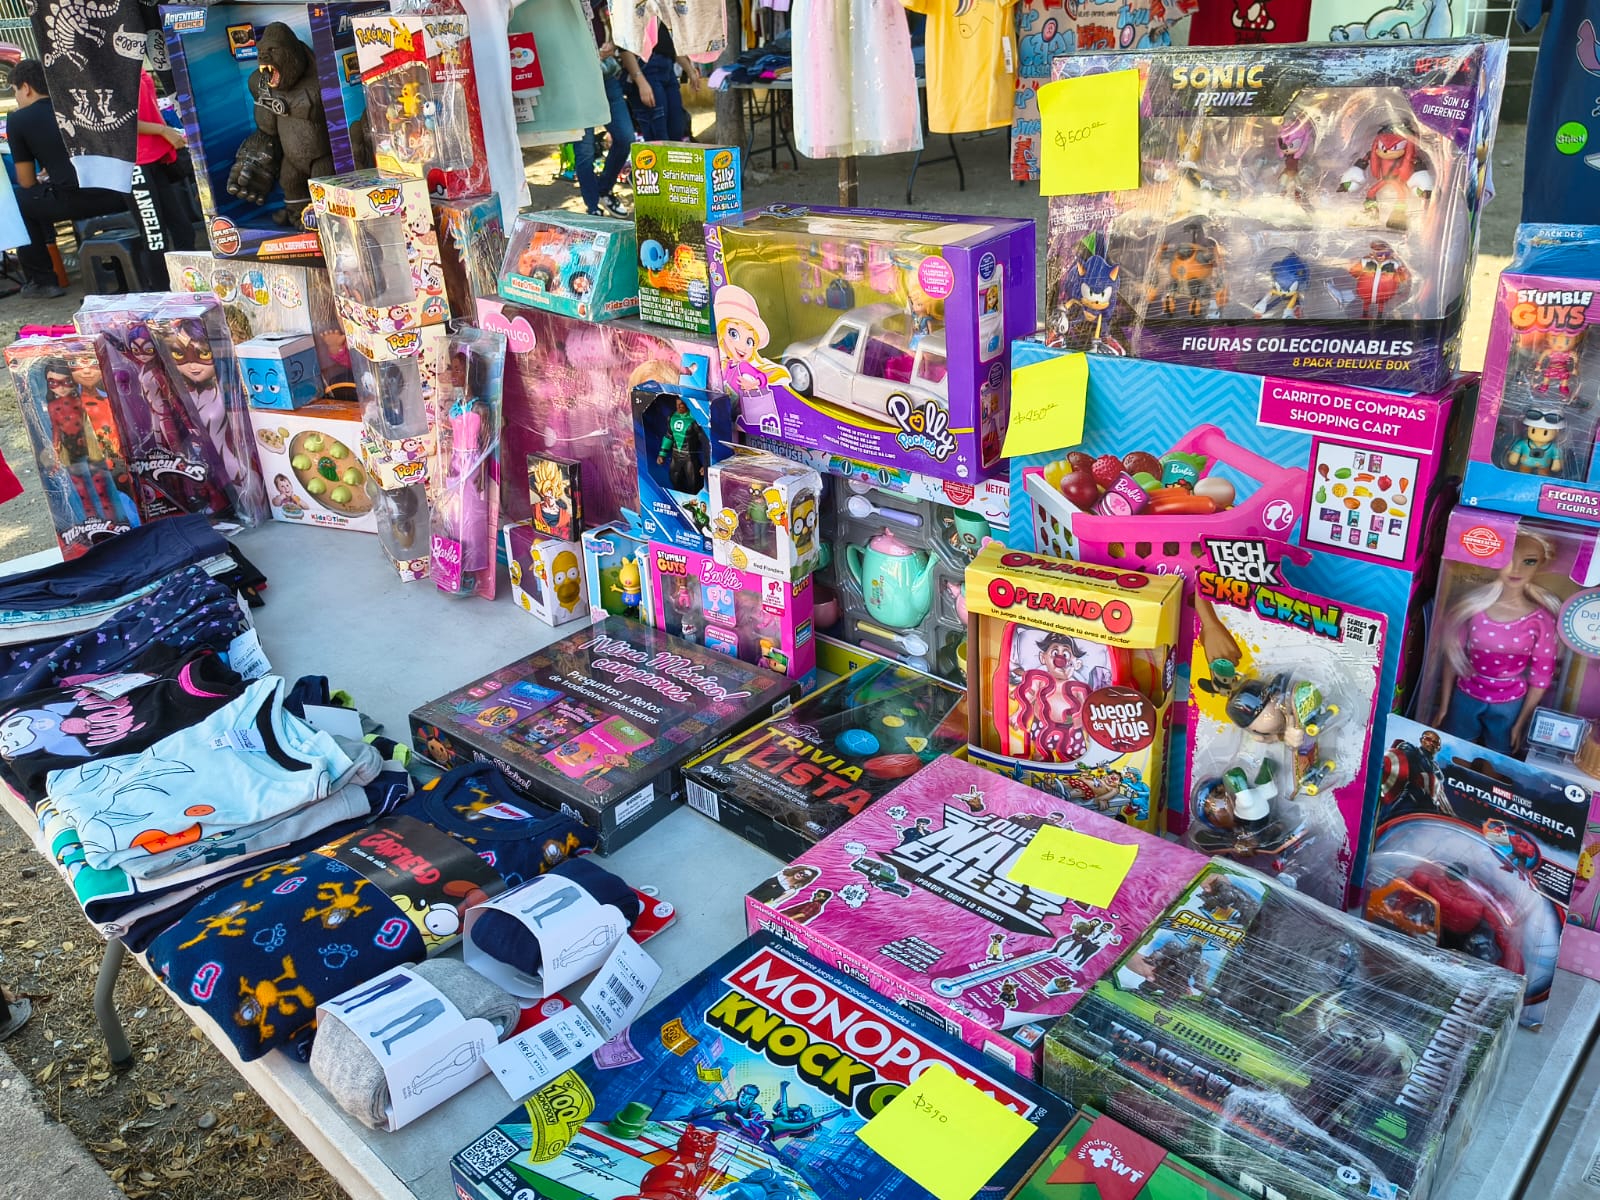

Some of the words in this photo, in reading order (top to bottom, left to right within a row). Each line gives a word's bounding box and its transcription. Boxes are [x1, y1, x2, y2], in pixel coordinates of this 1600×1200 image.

[164, 10, 205, 26] ADVENTURE
[176, 20, 202, 29] FORCE
[1172, 66, 1264, 90] SONIC
[1194, 91, 1258, 107] PRIME
[1442, 96, 1458, 107] SON
[1459, 98, 1469, 108] 16
[1422, 104, 1466, 120] DIFERENTES
[694, 153, 703, 163] 3+
[635, 169, 659, 185] Silly
[662, 170, 680, 180] Safari
[680, 171, 704, 183] Animals
[712, 168, 734, 184] Silly
[637, 185, 660, 194] scents
[669, 183, 698, 195] Animales
[713, 181, 735, 192] scents
[367, 187, 400, 207] POP!
[669, 193, 679, 203] del
[680, 195, 699, 205] safari
[713, 193, 736, 203] DOUGH
[328, 202, 356, 218] LABUBU
[711, 201, 739, 212] MASILLA
[133, 189, 164, 251] ANGELES
[1540, 230, 1563, 238] PACK
[1517, 289, 1593, 306] STUMBLE
[1511, 303, 1585, 328] GUYS
[386, 333, 417, 351] POP!
[1182, 337, 1252, 351] FIGURAS
[1257, 338, 1414, 356] COLECCIONABLES
[1292, 358, 1299, 367] 8
[1303, 358, 1333, 368] PACK
[1336, 359, 1383, 370] DELUXE
[1386, 360, 1411, 371] BOX
[1272, 387, 1331, 407] CARRITO
[1333, 395, 1351, 409] DE
[1354, 400, 1426, 421] COMPRAS
[888, 396, 956, 459] Polly
[1289, 408, 1360, 431] SHOPPING
[1362, 419, 1402, 436] CART
[898, 433, 936, 455] Pocket
[957, 454, 967, 463] 4+
[393, 460, 423, 478] POP!
[1171, 464, 1196, 477] Barbie
[985, 482, 1010, 497] NETFLI
[1115, 478, 1143, 503] Barbie
[1548, 490, 1598, 505] FIGURAS
[653, 501, 671, 510] GREEN
[653, 507, 678, 517] LANTERN
[1556, 502, 1599, 515] FIGURAS
[644, 520, 656, 532] DC
[432, 537, 460, 564] Barbie
[657, 550, 687, 564] STUMBLE
[1206, 540, 1266, 564] TECH
[657, 559, 687, 575] GUYS
[700, 559, 743, 589] Barbie
[763, 564, 785, 575] Flanders
[1001, 552, 1149, 589] OPERANDO
[1218, 560, 1281, 585] DECK
[793, 579, 809, 597] GUYS
[987, 577, 1133, 634] OPERANDO
[1199, 571, 1251, 608] SK8
[1254, 585, 1342, 640] CREW
[991, 607, 1000, 615] Un
[1000, 610, 1017, 619] juego
[1027, 616, 1054, 628] habilidad
[1055, 623, 1075, 633] donde
[1107, 635, 1131, 645] doctor
[1346, 625, 1364, 635] SERIE
[1347, 617, 1367, 629] SERIES
[1346, 632, 1364, 642] SERIE
[1366, 624, 1378, 645] 1
[645, 651, 751, 702] México!
[549, 674, 559, 683] de
[560, 677, 609, 705] tradiciones
[608, 700, 660, 725] mexicanas
[567, 671, 620, 698] Preguntas
[620, 692, 630, 703] y
[629, 694, 664, 714] Retos
[1090, 700, 1143, 722] Juegos
[1093, 720, 1104, 731] de
[738, 727, 863, 783] TRIVIA
[747, 746, 872, 816] LISTA
[1493, 786, 1512, 800] MARVEL
[1512, 794, 1532, 808] STUDIOS
[1569, 789, 1583, 799] 4+
[1447, 777, 1507, 809] CAPTAIN
[1508, 803, 1576, 838] AMERICA
[359, 833, 441, 885] GARFIELD
[893, 840, 1064, 921] ERES?
[944, 890, 967, 905] TODOS
[967, 901, 976, 910] LO
[975, 904, 1004, 923] SOMOS!
[1176, 911, 1243, 945] SMASH
[837, 959, 850, 974] 10
[850, 968, 870, 983] años
[781, 948, 816, 971] emocionante
[815, 967, 833, 981] juego
[833, 977, 843, 985] de
[841, 984, 870, 1001] negociar
[868, 999, 910, 1026] propiedades
[709, 993, 870, 1096] KNOCK
[1172, 1021, 1242, 1062] RHINOX
[537, 1092, 558, 1125] MONOPOLY
[543, 1085, 580, 1119] 100
[495, 1170, 503, 1179] DE
[501, 1174, 517, 1191] MESA
[500, 1167, 518, 1182] JUEGO
[1342, 1168, 1358, 1180] 6+
[489, 1175, 513, 1197] FAMILIAR
